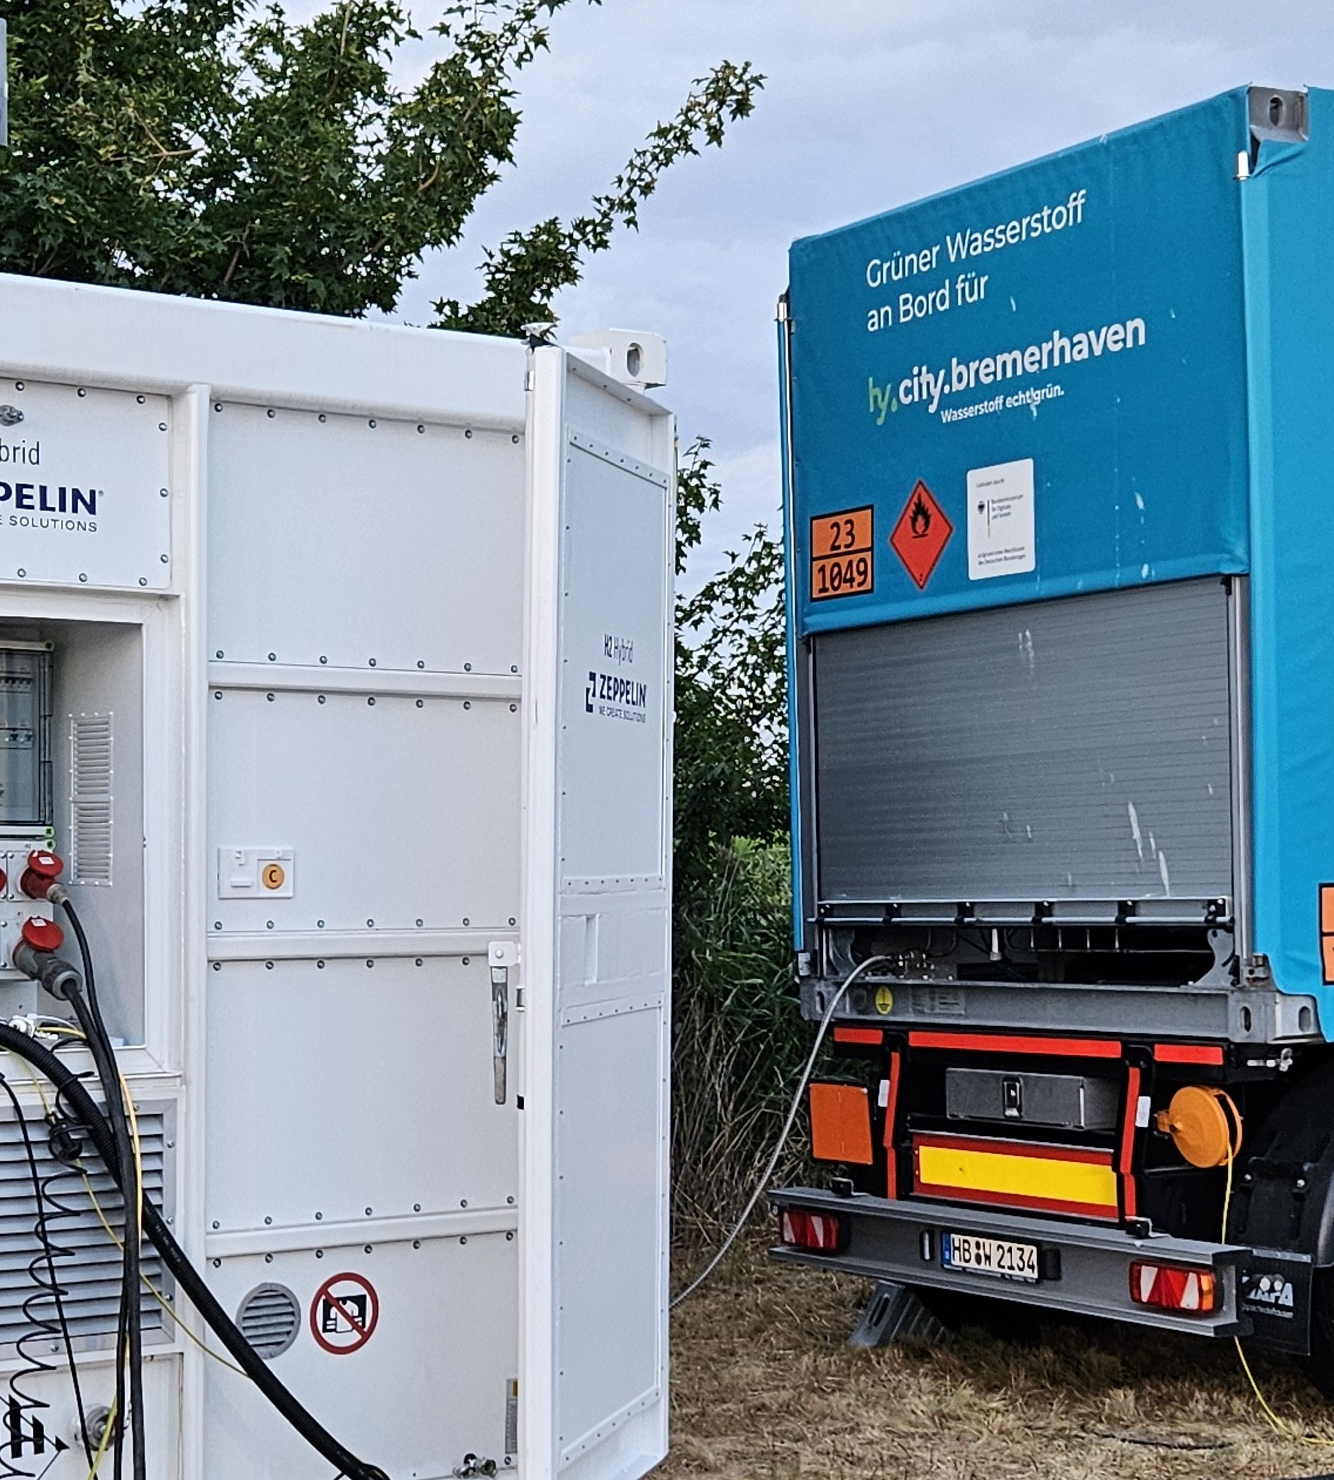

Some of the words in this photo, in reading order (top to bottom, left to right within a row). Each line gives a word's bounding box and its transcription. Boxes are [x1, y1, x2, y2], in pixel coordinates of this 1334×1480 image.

[866, 244, 939, 288] Grüner
[946, 189, 1087, 263] Wasserstoff
[867, 305, 892, 332] an
[899, 279, 950, 323] Bord
[955, 271, 989, 306] für
[941, 394, 1004, 424] Wasserstoff
[1006, 388, 1032, 408] echt
[1033, 383, 1065, 407] grün.
[8, 514, 98, 533] SOLUTIONS
[830, 519, 856, 551] 23
[817, 557, 869, 593] 1049
[604, 634, 613, 658] H2
[614, 637, 634, 666] Hybrid
[599, 674, 647, 708] ZEPPELIN
[269, 869, 277, 883] C
[952, 1237, 972, 1264] HB
[983, 1242, 992, 1267] W
[997, 1244, 1036, 1275] 2134
